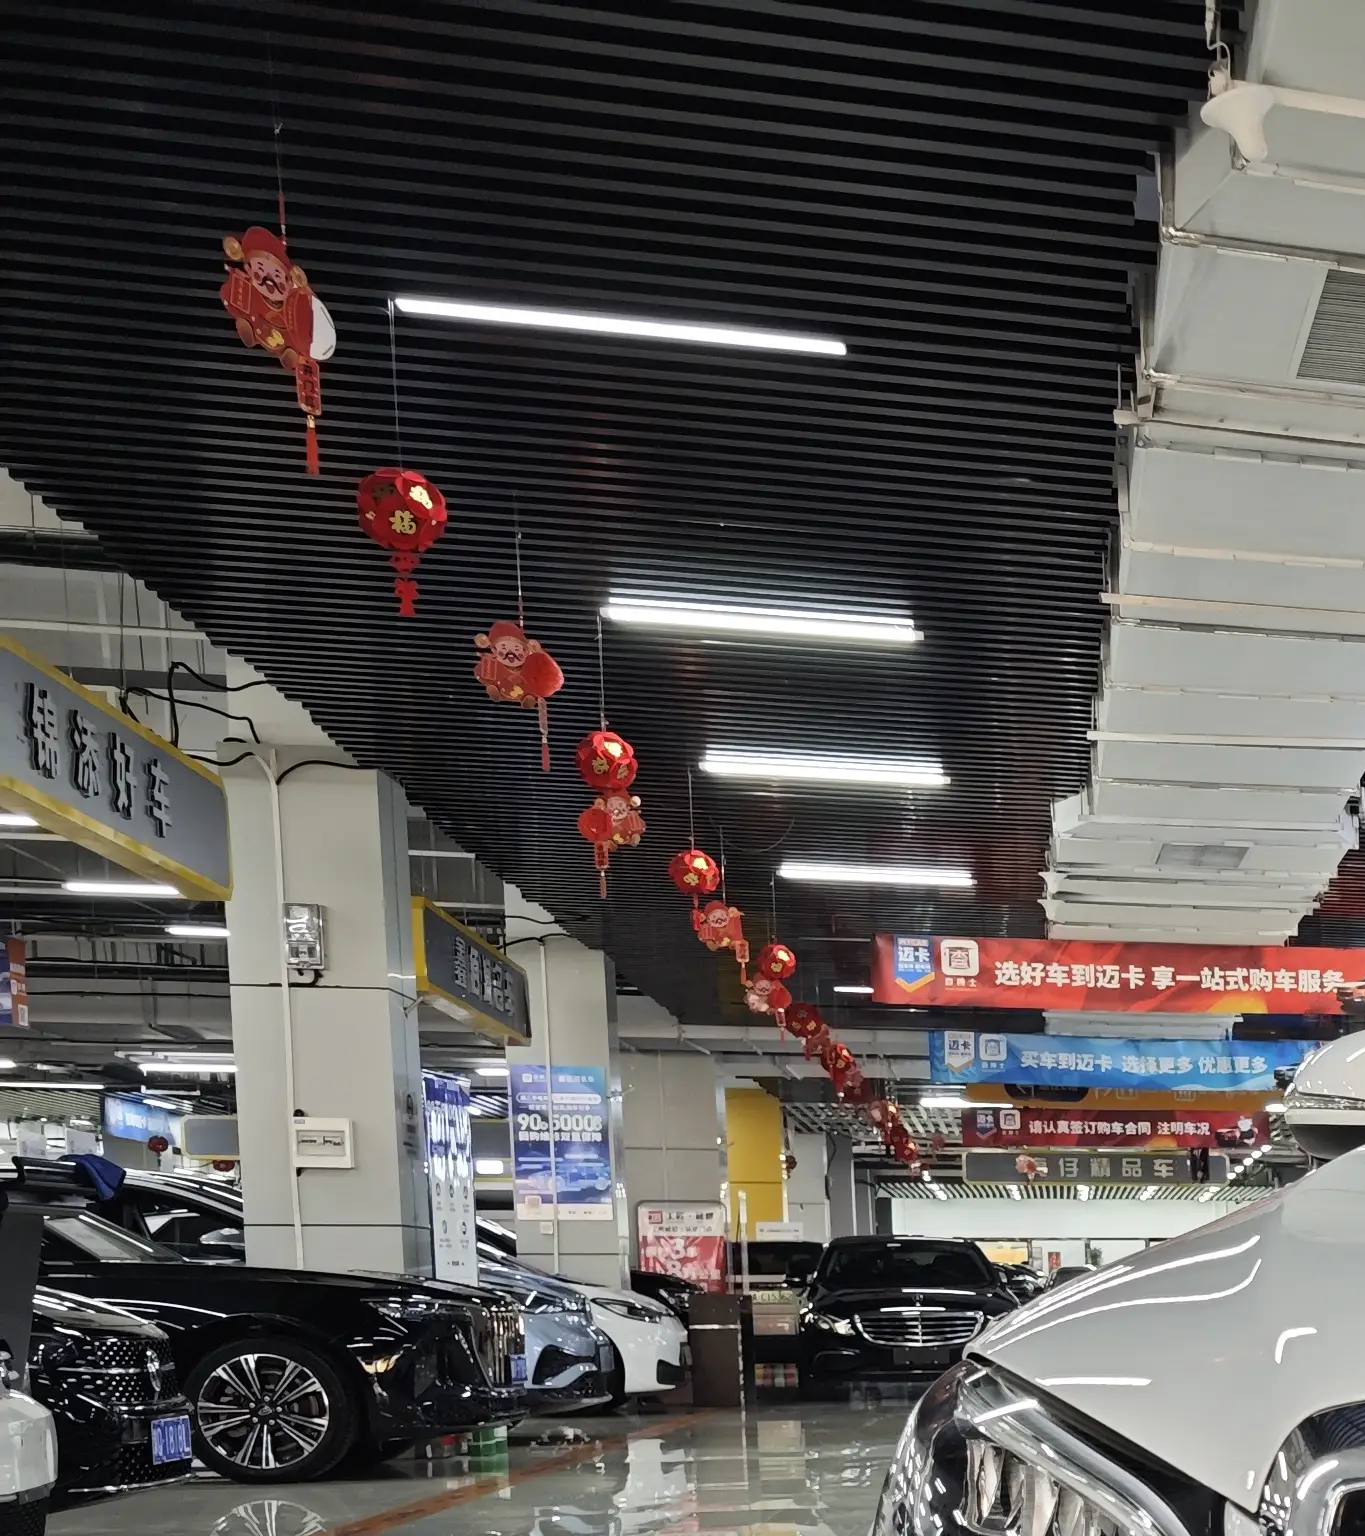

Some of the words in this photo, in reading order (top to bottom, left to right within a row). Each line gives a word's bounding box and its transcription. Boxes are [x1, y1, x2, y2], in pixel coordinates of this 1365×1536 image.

[898, 946, 930, 962] 迈卡
[994, 959, 1145, 990] 选好车到迈卡
[1151, 965, 1345, 995] 享一站式购车服务
[948, 1040, 971, 1050] 迈卡
[1020, 1051, 1112, 1072] 买车到迈卡
[1122, 1055, 1194, 1075] 选择更多
[1198, 1056, 1267, 1074] 优惠更多
[1029, 1120, 1151, 1135] 请认真签订购车合同
[1157, 1121, 1210, 1135] 注明车况
